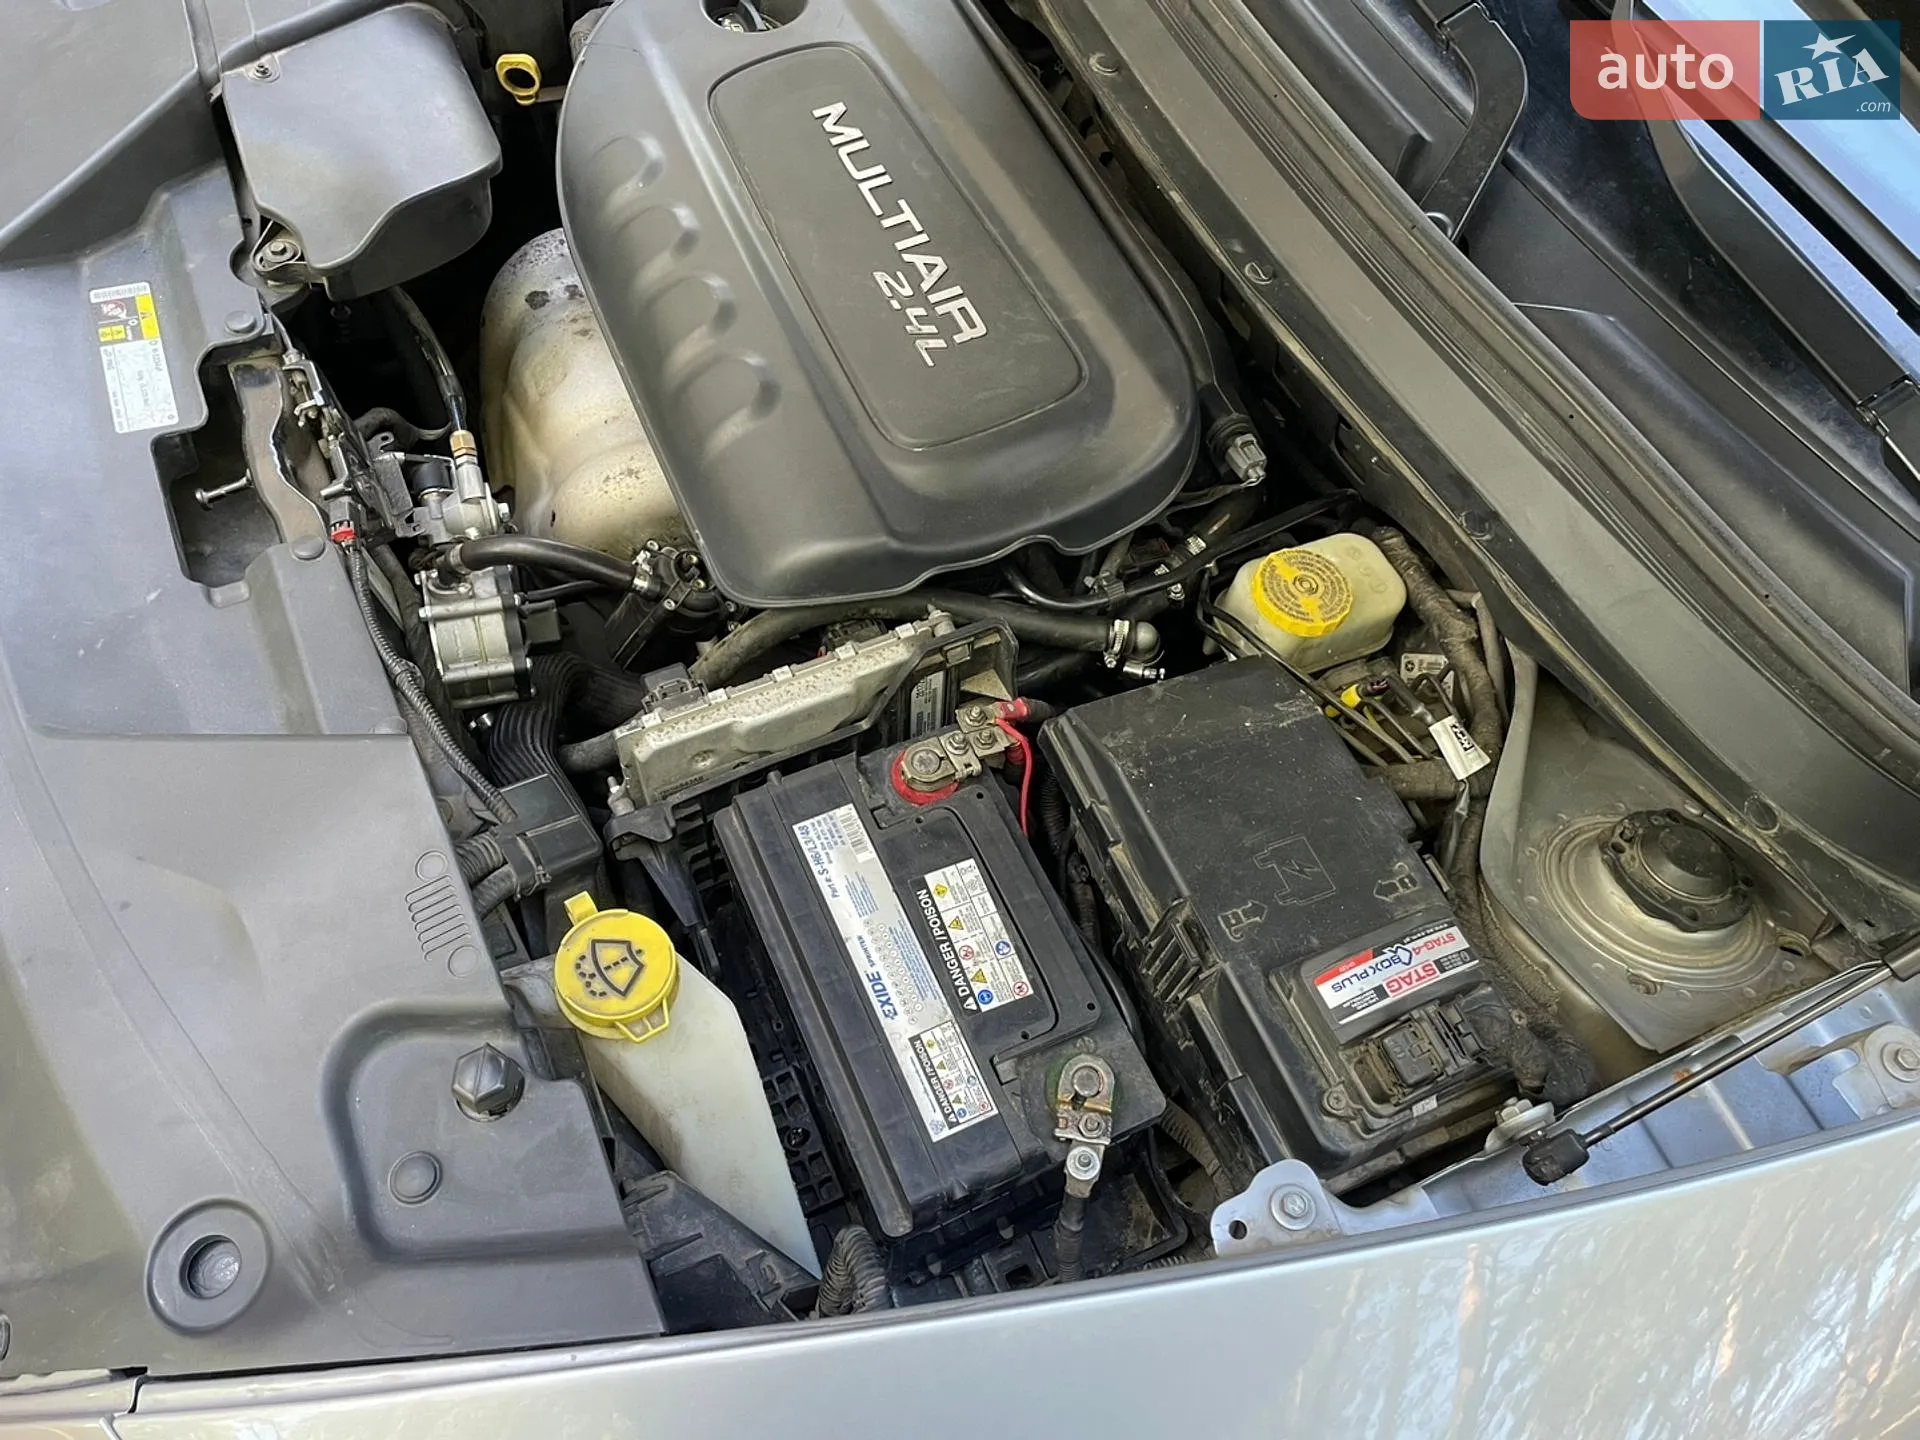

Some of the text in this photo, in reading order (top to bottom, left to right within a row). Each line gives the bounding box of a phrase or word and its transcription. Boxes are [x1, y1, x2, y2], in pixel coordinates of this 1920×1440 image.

[811, 101, 988, 345] MULTIAIR
[872, 271, 948, 368] 2.4L
[1411, 932, 1457, 957] STAG-4
[939, 941, 971, 997] DANGER
[1331, 970, 1369, 993] PLUS
[1384, 961, 1439, 994] STAG
[866, 971, 899, 1020] EXIDE
[930, 1075, 954, 1114] DANGER
